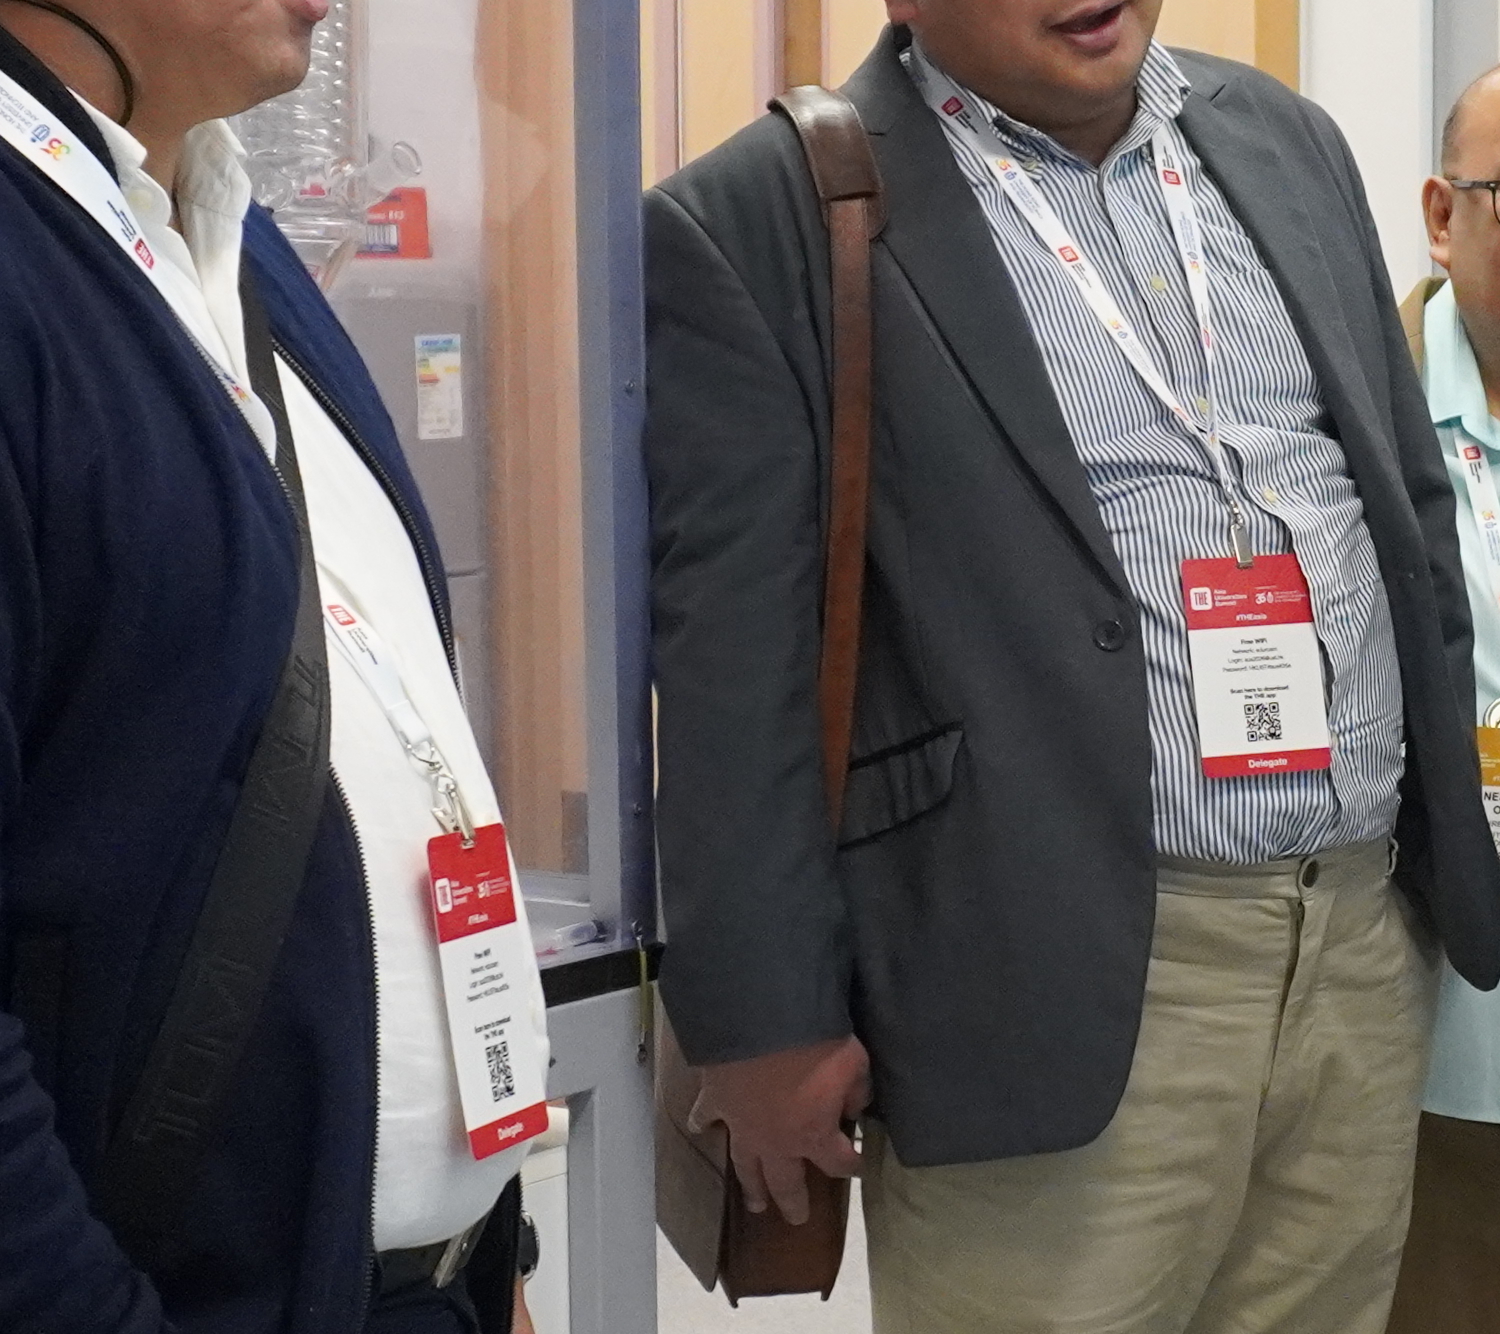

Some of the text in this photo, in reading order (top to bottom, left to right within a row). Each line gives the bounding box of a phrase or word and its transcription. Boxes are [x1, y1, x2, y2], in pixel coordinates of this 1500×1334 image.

[1194, 592, 1209, 606] THE
[329, 607, 353, 623] THE
[1248, 758, 1288, 768] Delegate
[497, 1122, 524, 1141] Delegate
